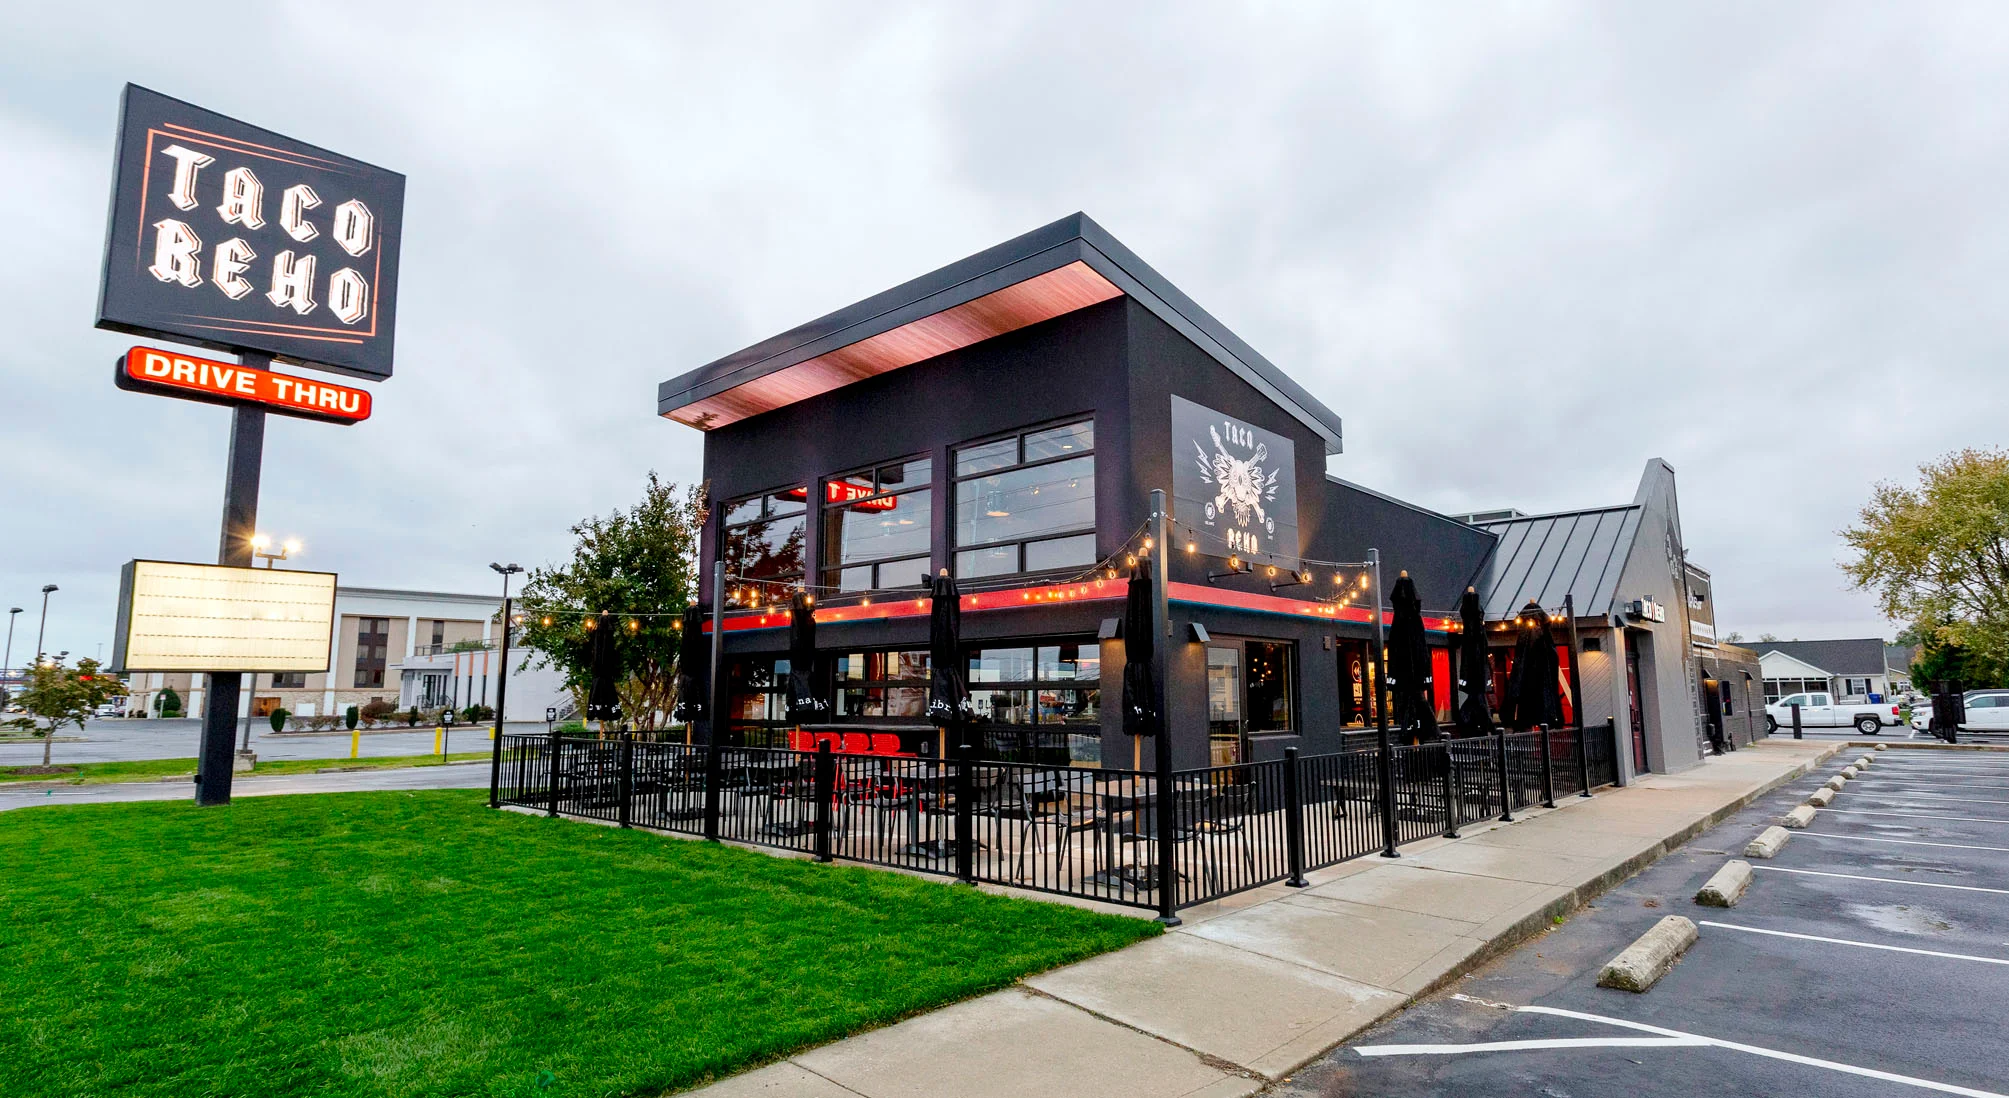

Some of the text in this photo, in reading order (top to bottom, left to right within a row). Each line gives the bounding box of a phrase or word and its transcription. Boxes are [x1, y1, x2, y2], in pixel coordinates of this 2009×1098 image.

[161, 144, 375, 257] TACO
[149, 218, 369, 325] REHO
[145, 353, 361, 413] DRIVE THRU
[1224, 421, 1253, 450] TACO
